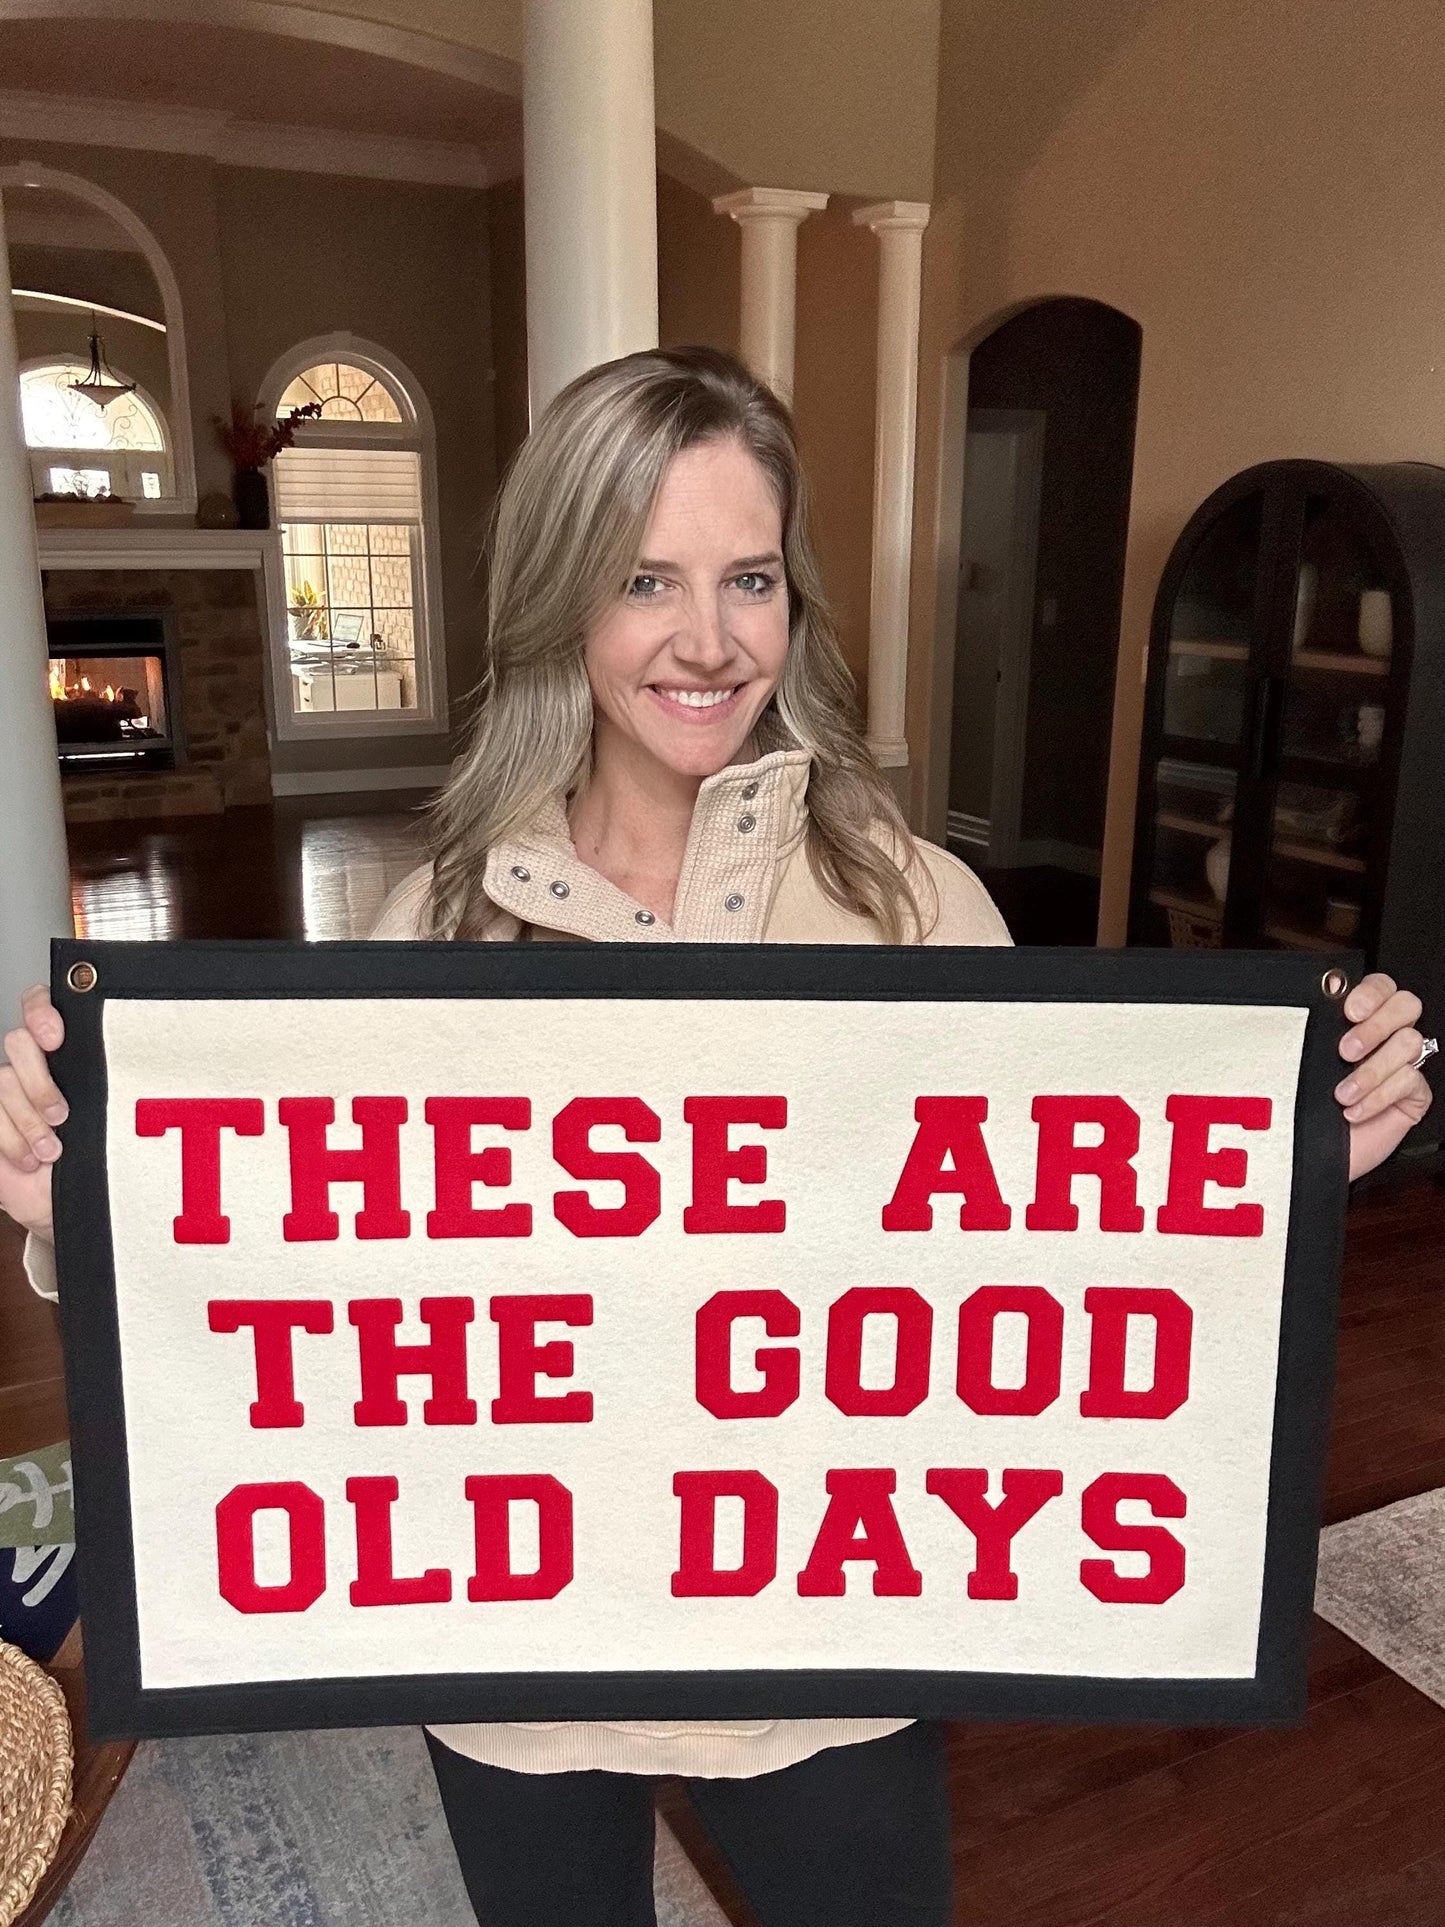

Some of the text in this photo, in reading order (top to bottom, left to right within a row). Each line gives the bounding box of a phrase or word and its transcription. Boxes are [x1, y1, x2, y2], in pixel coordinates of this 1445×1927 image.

[135, 1094, 1273, 1245] THESE ARE
[207, 1286, 1194, 1429] THE GOOD
[215, 1473, 575, 1615] OLD
[670, 1468, 1188, 1605] DAYS
